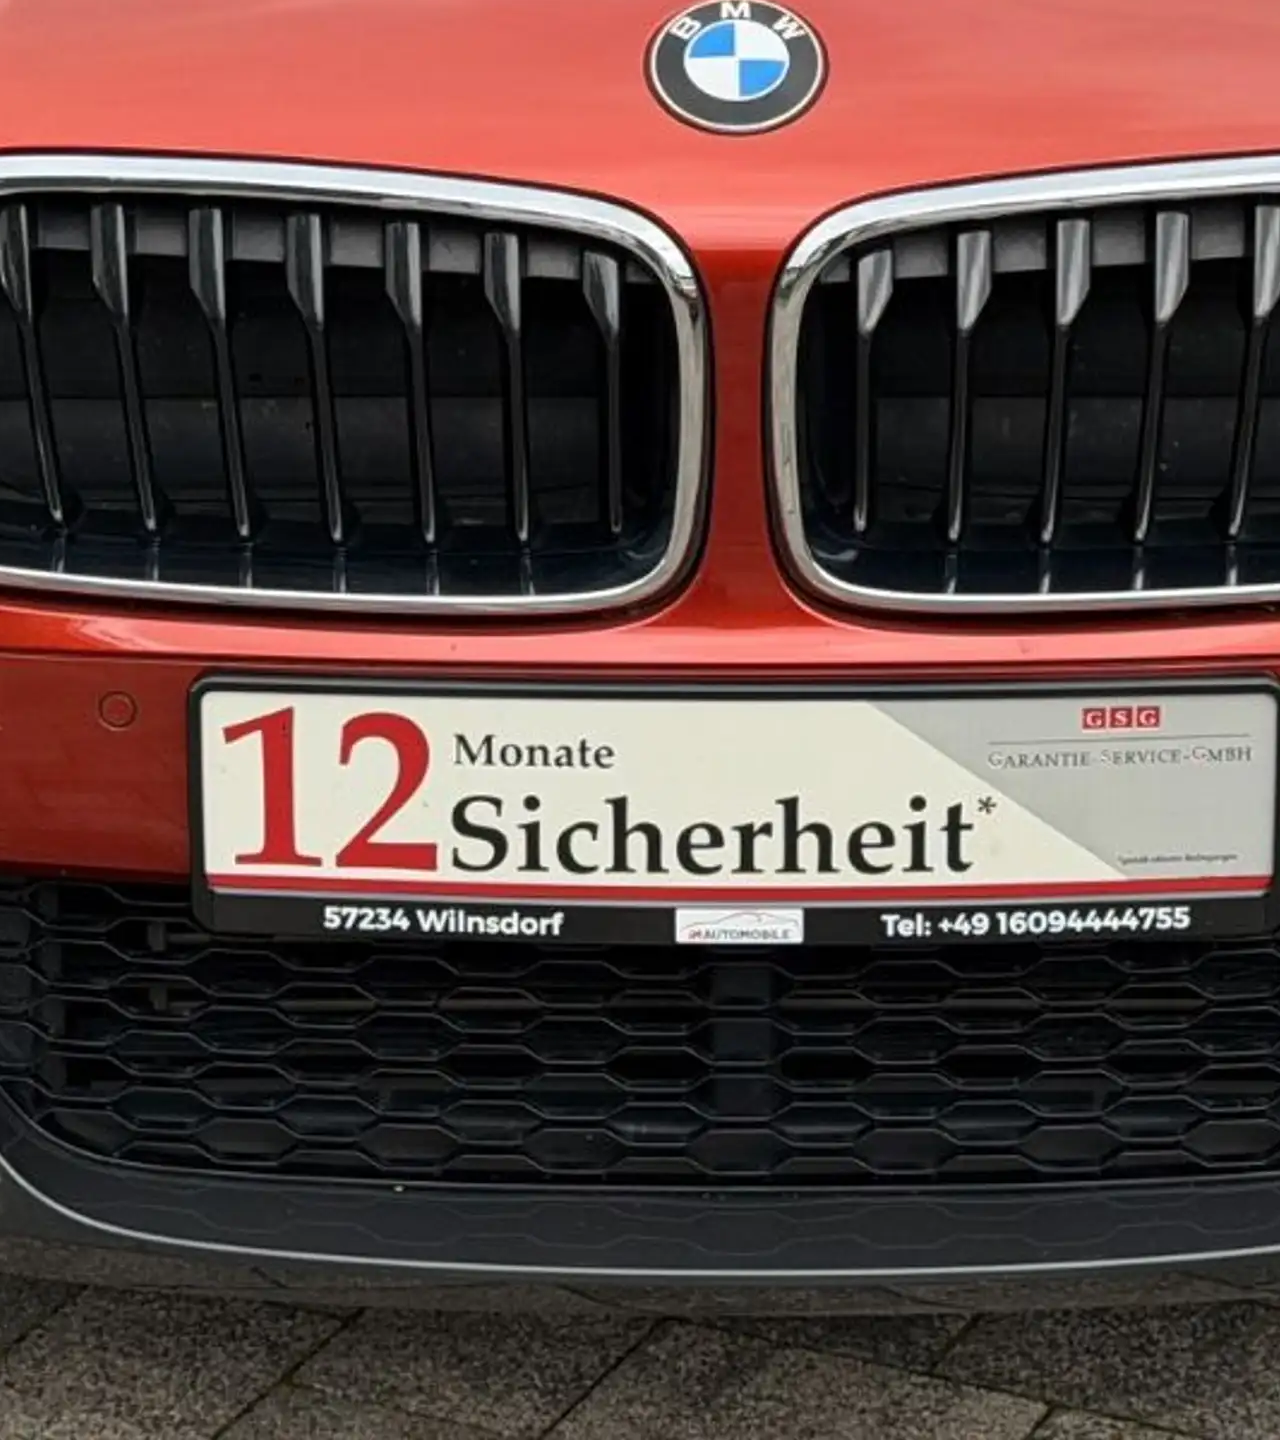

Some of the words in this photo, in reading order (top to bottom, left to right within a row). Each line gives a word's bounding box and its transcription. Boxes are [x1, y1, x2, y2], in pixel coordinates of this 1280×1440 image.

[669, 0, 806, 41] BMW
[1081, 705, 1161, 731] GSG
[451, 733, 616, 770] Monate
[221, 705, 439, 872] 12
[322, 905, 411, 931] 57234
[415, 909, 565, 936] Wilnsdorf
[880, 913, 931, 937] Tel:
[937, 912, 990, 936] +49
[995, 905, 1192, 935] 16094444755
